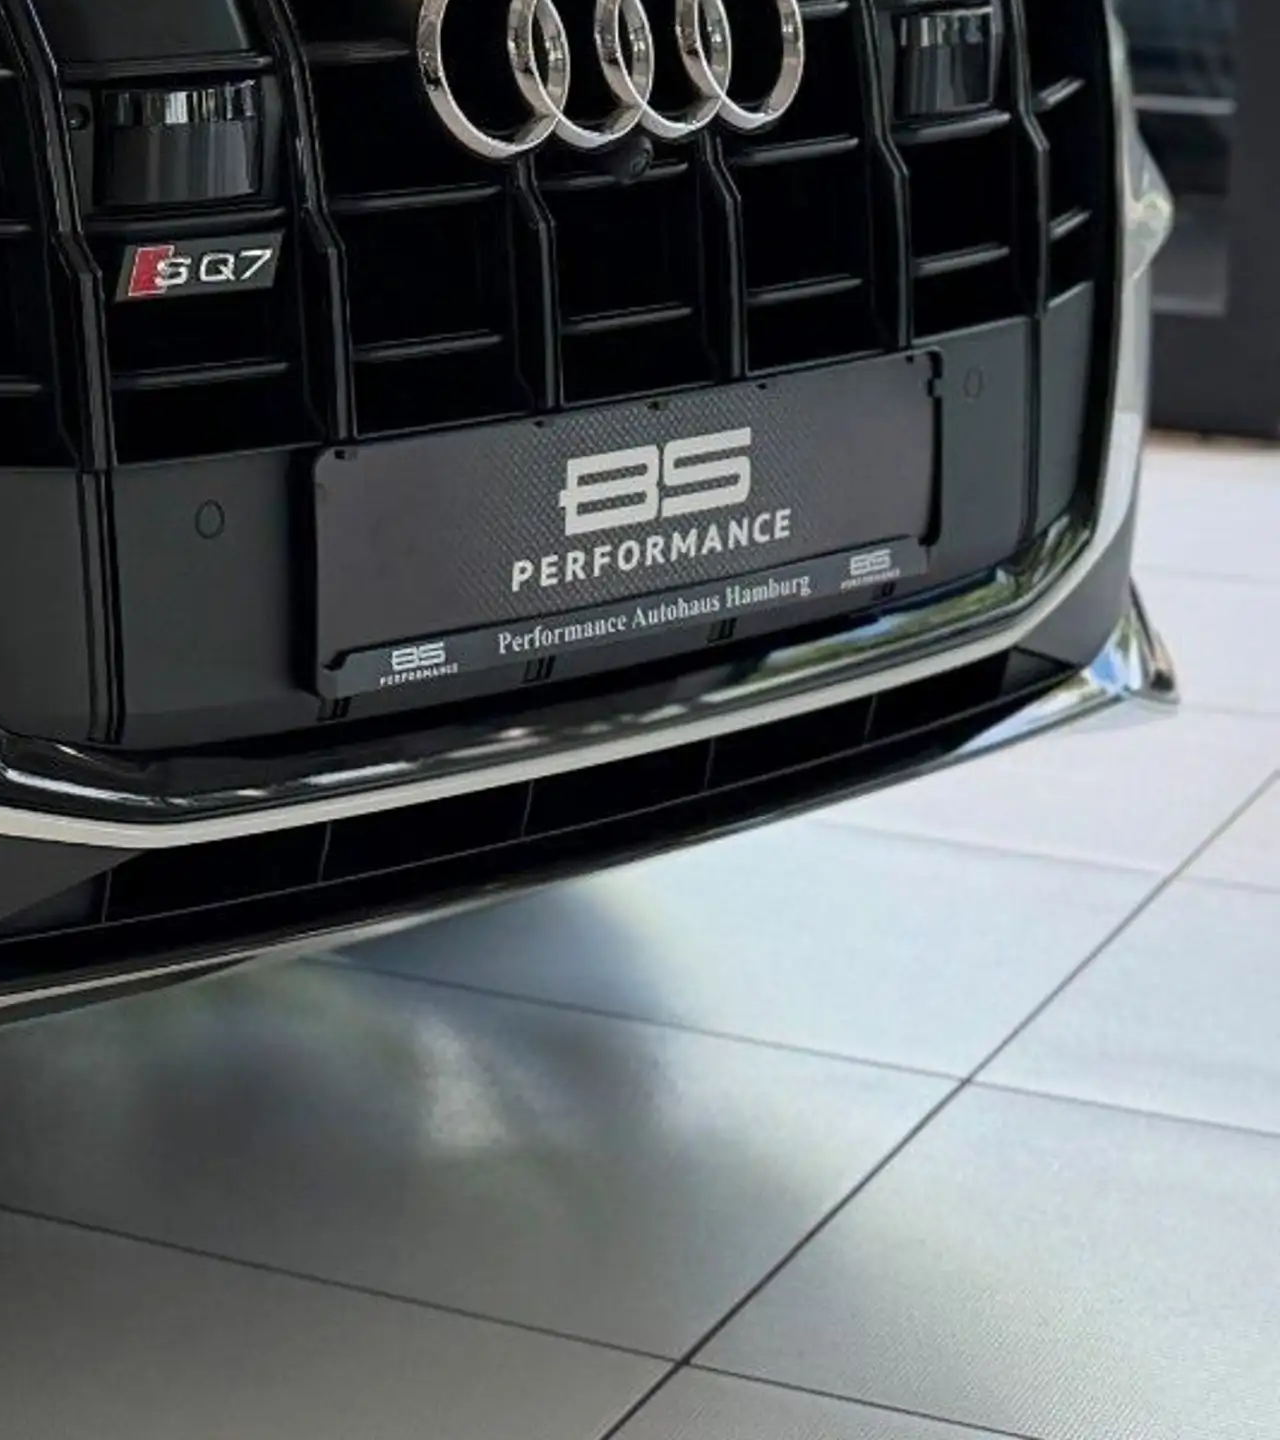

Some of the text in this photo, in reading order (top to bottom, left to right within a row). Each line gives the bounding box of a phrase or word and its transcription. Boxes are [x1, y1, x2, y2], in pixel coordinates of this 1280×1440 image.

[153, 247, 274, 287] SQ7
[559, 426, 751, 536] BS
[511, 508, 792, 592] PERFORMANCE
[497, 612, 627, 654] Performance
[631, 592, 721, 629] Autohaus
[725, 575, 811, 608] Hamburg
